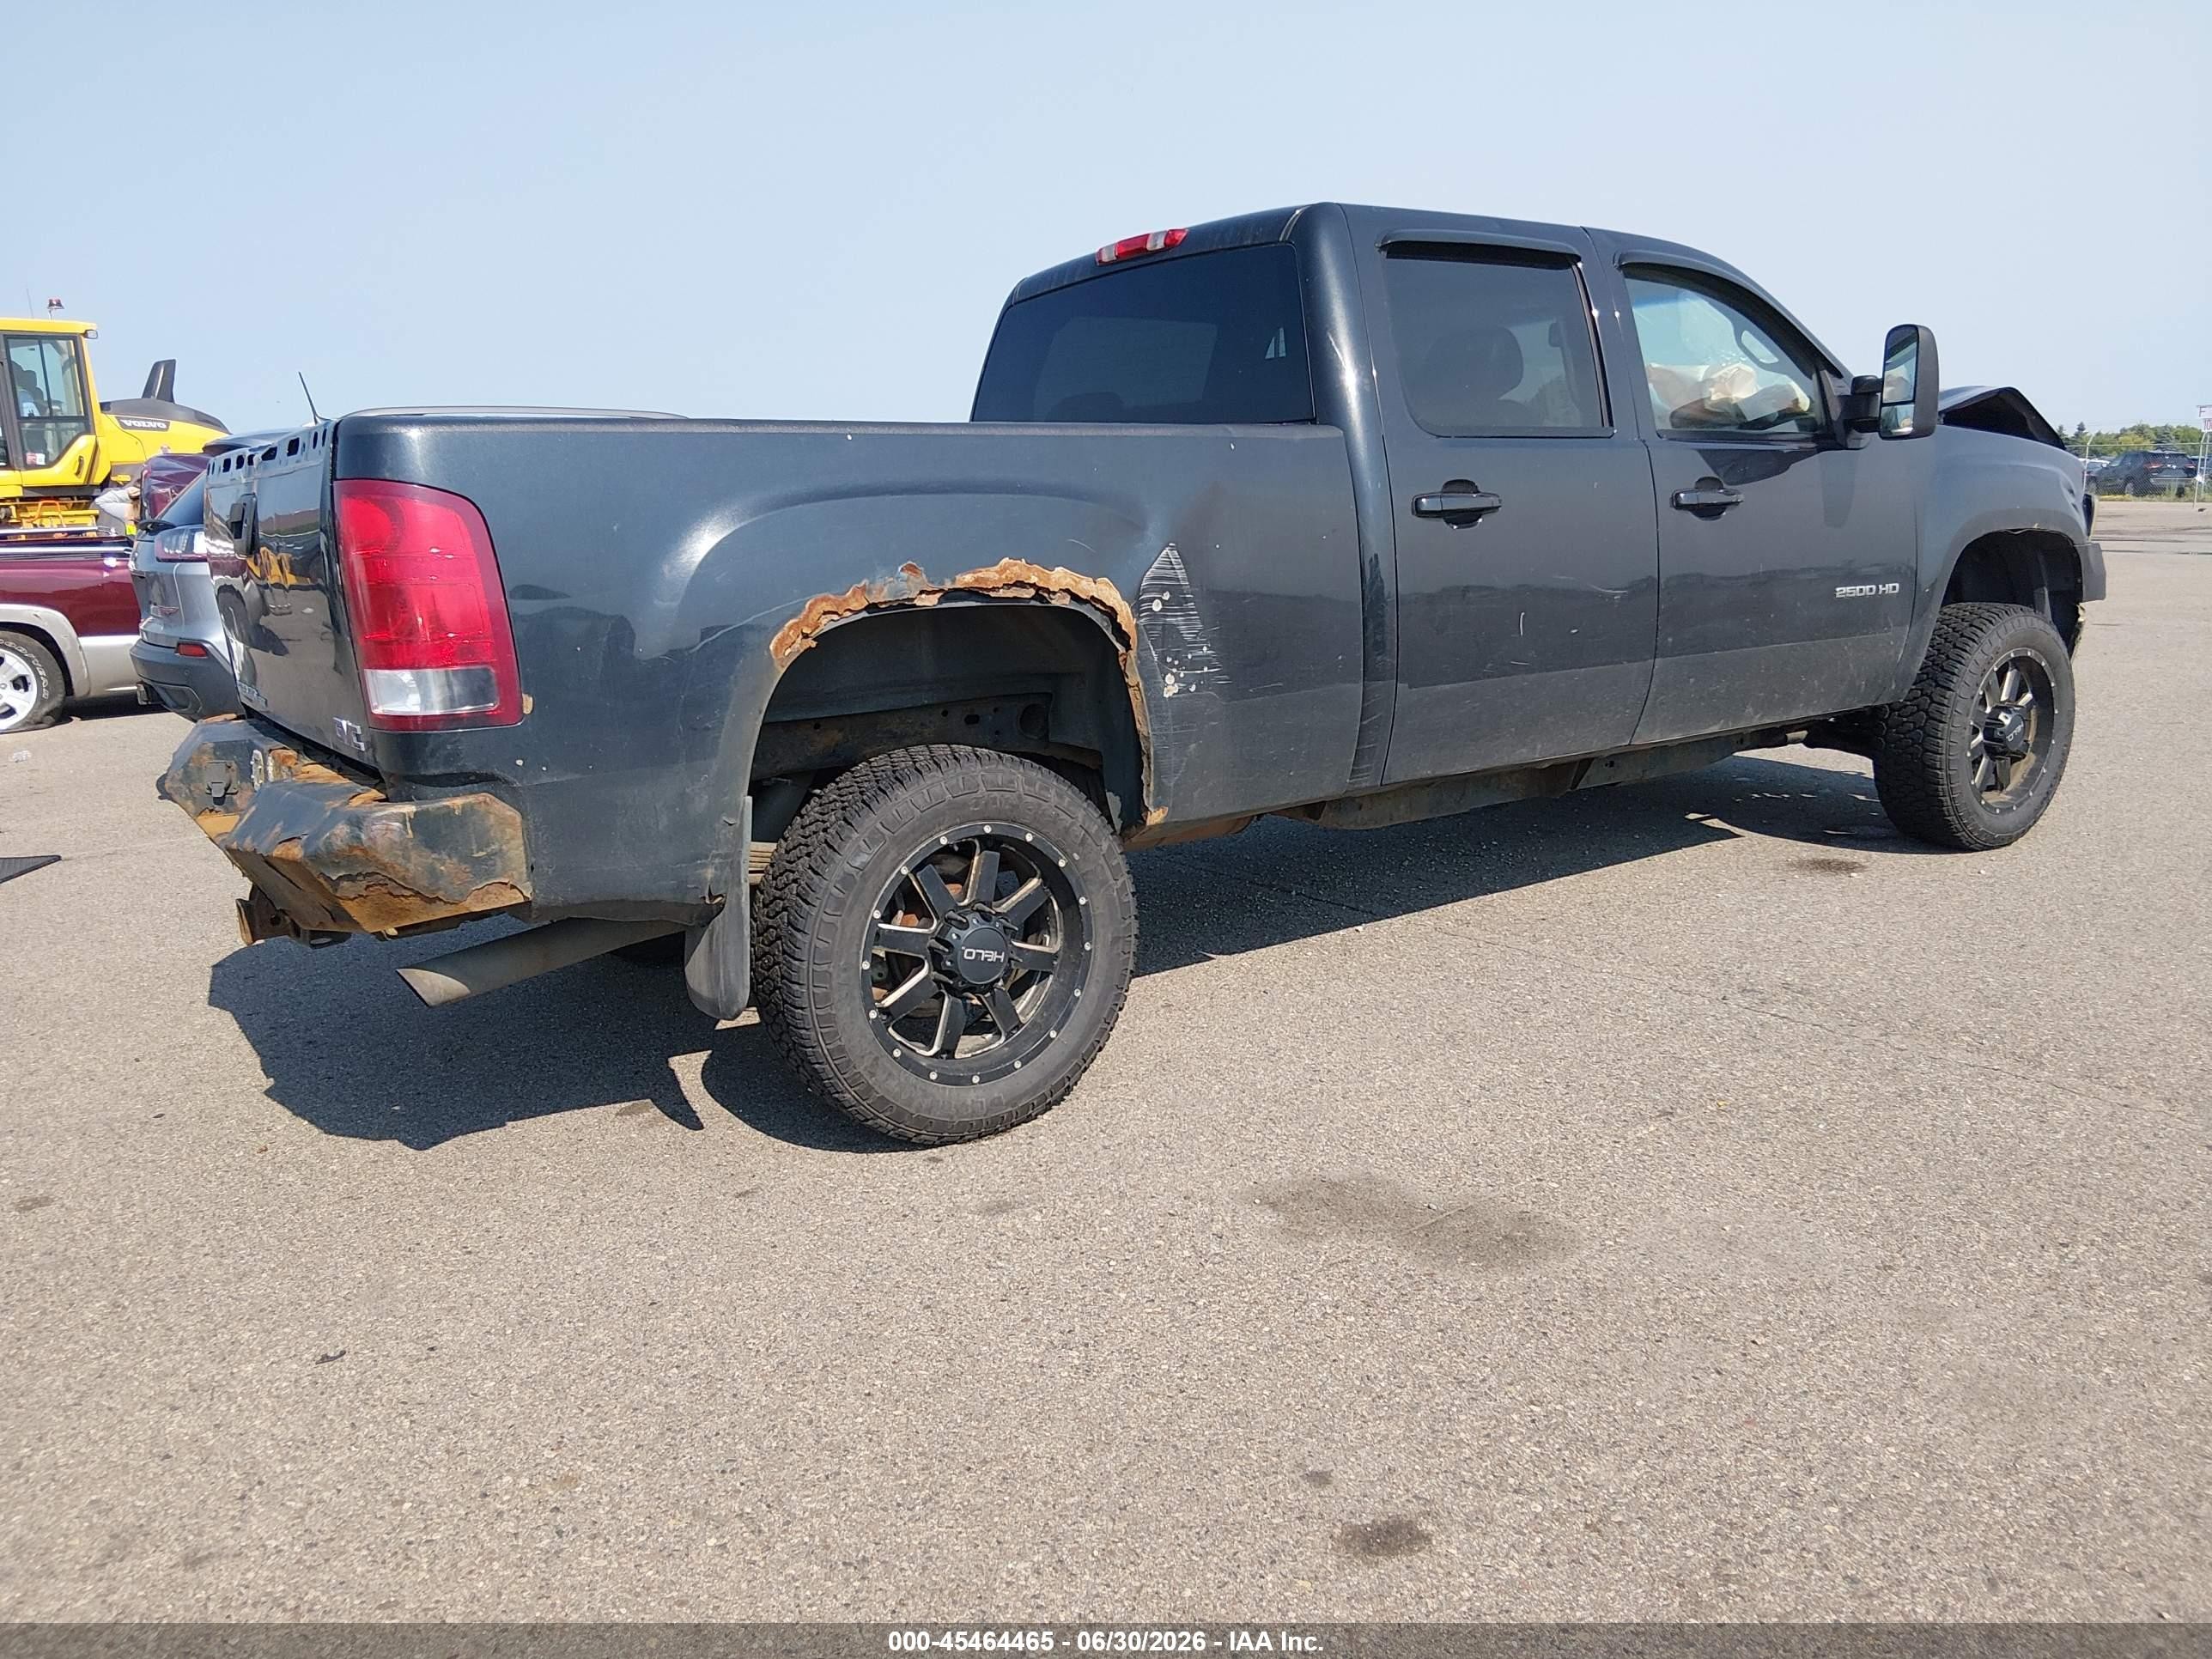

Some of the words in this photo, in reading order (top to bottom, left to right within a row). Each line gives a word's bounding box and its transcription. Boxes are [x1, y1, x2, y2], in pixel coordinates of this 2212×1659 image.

[120, 419, 167, 428] VOLVO
[1835, 585, 1876, 599] 2500
[1878, 583, 1899, 594] HD
